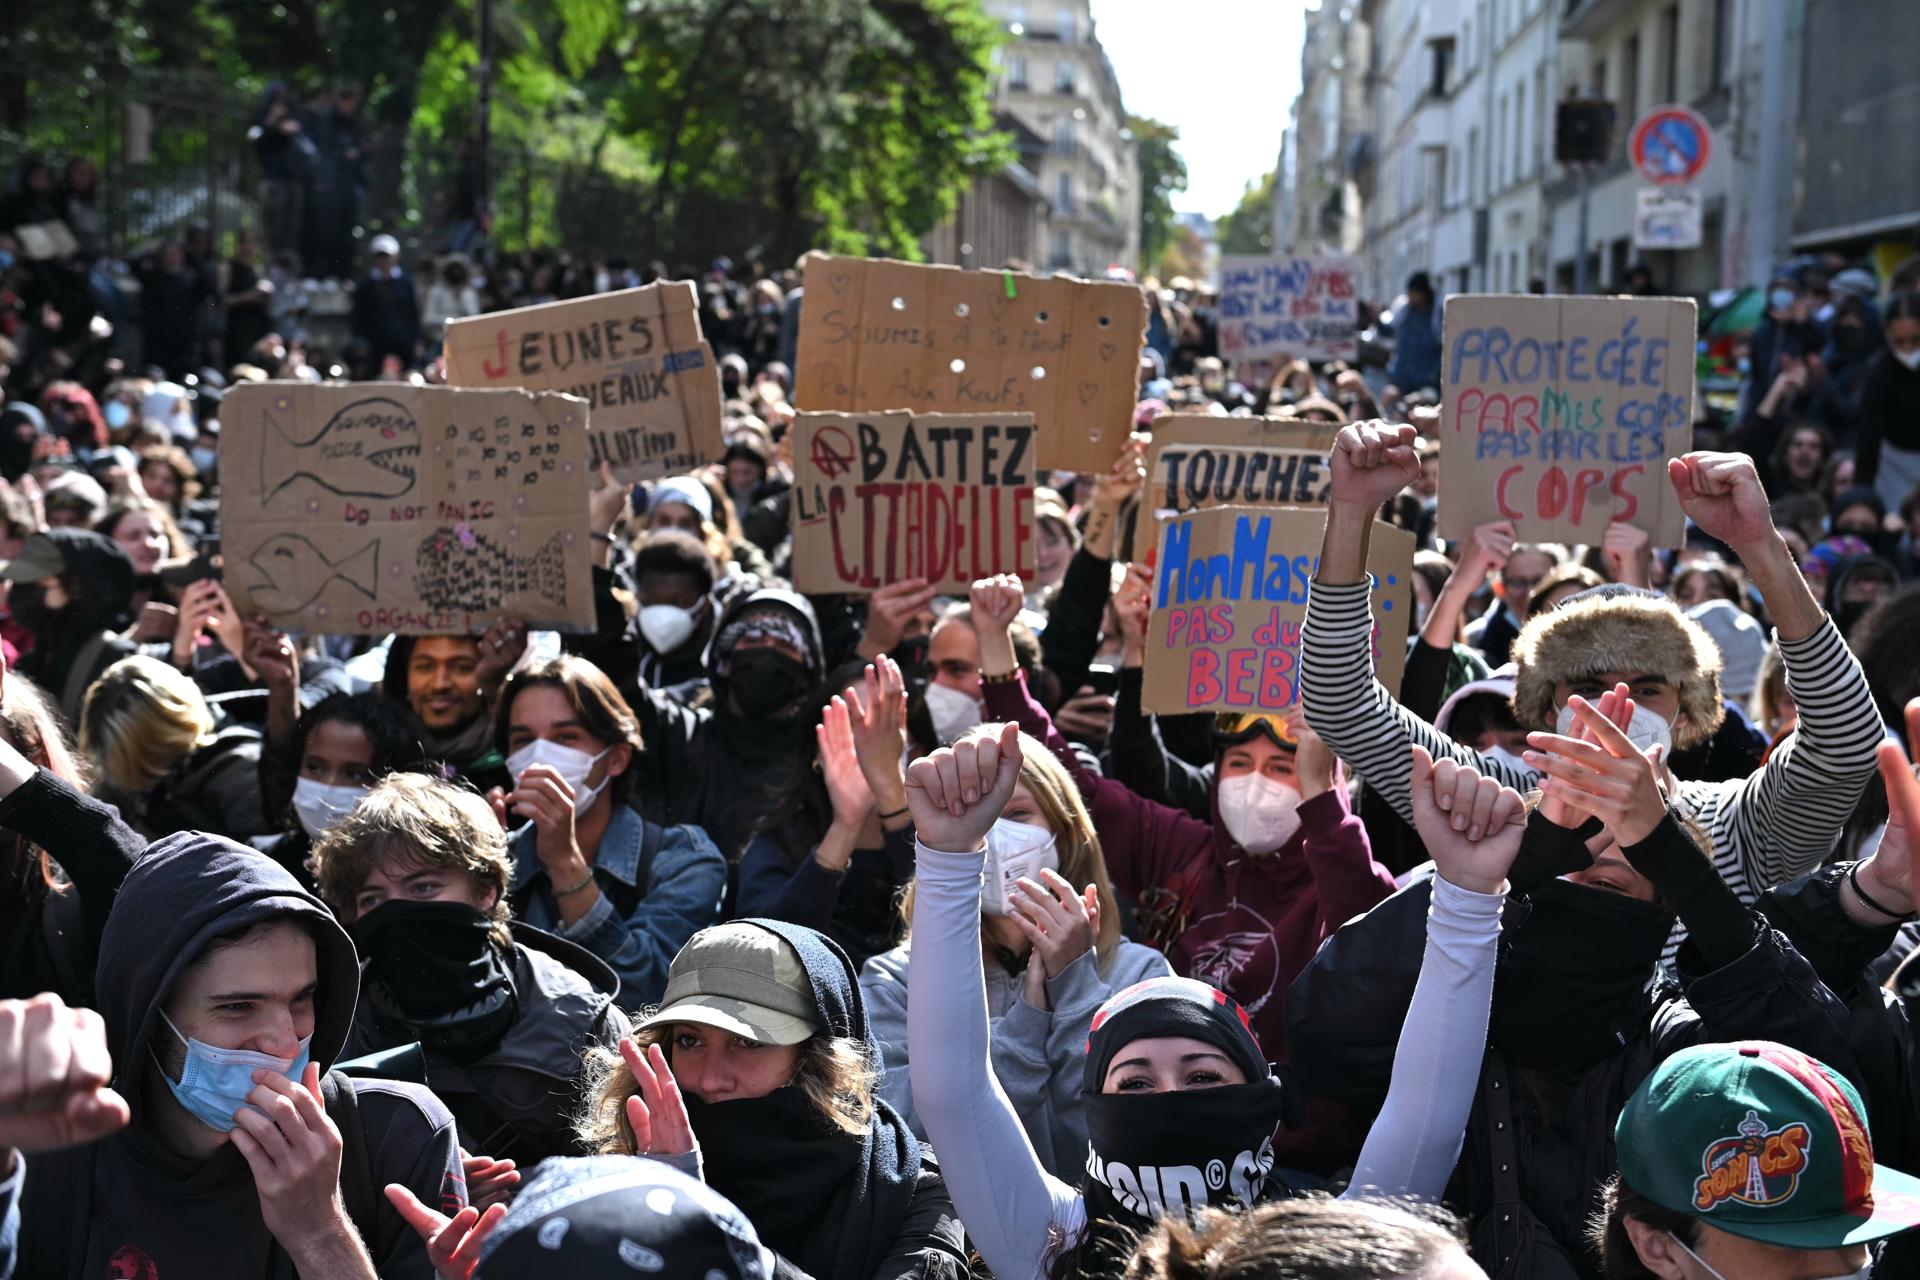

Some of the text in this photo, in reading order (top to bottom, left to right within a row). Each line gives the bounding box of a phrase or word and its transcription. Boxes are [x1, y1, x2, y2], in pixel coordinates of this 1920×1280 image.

[482, 316, 653, 379] JEUNES
[1450, 316, 1670, 387] PROTEGÉE
[1615, 391, 1689, 435] COPS
[390, 504, 427, 522] NOT
[437, 500, 495, 521] PANIC
[796, 483, 827, 521] LA
[1495, 463, 1646, 529] COPS
[828, 482, 1035, 588] CITADELLE
[1167, 603, 1235, 649] PAS
[1187, 646, 1302, 710] BEB
